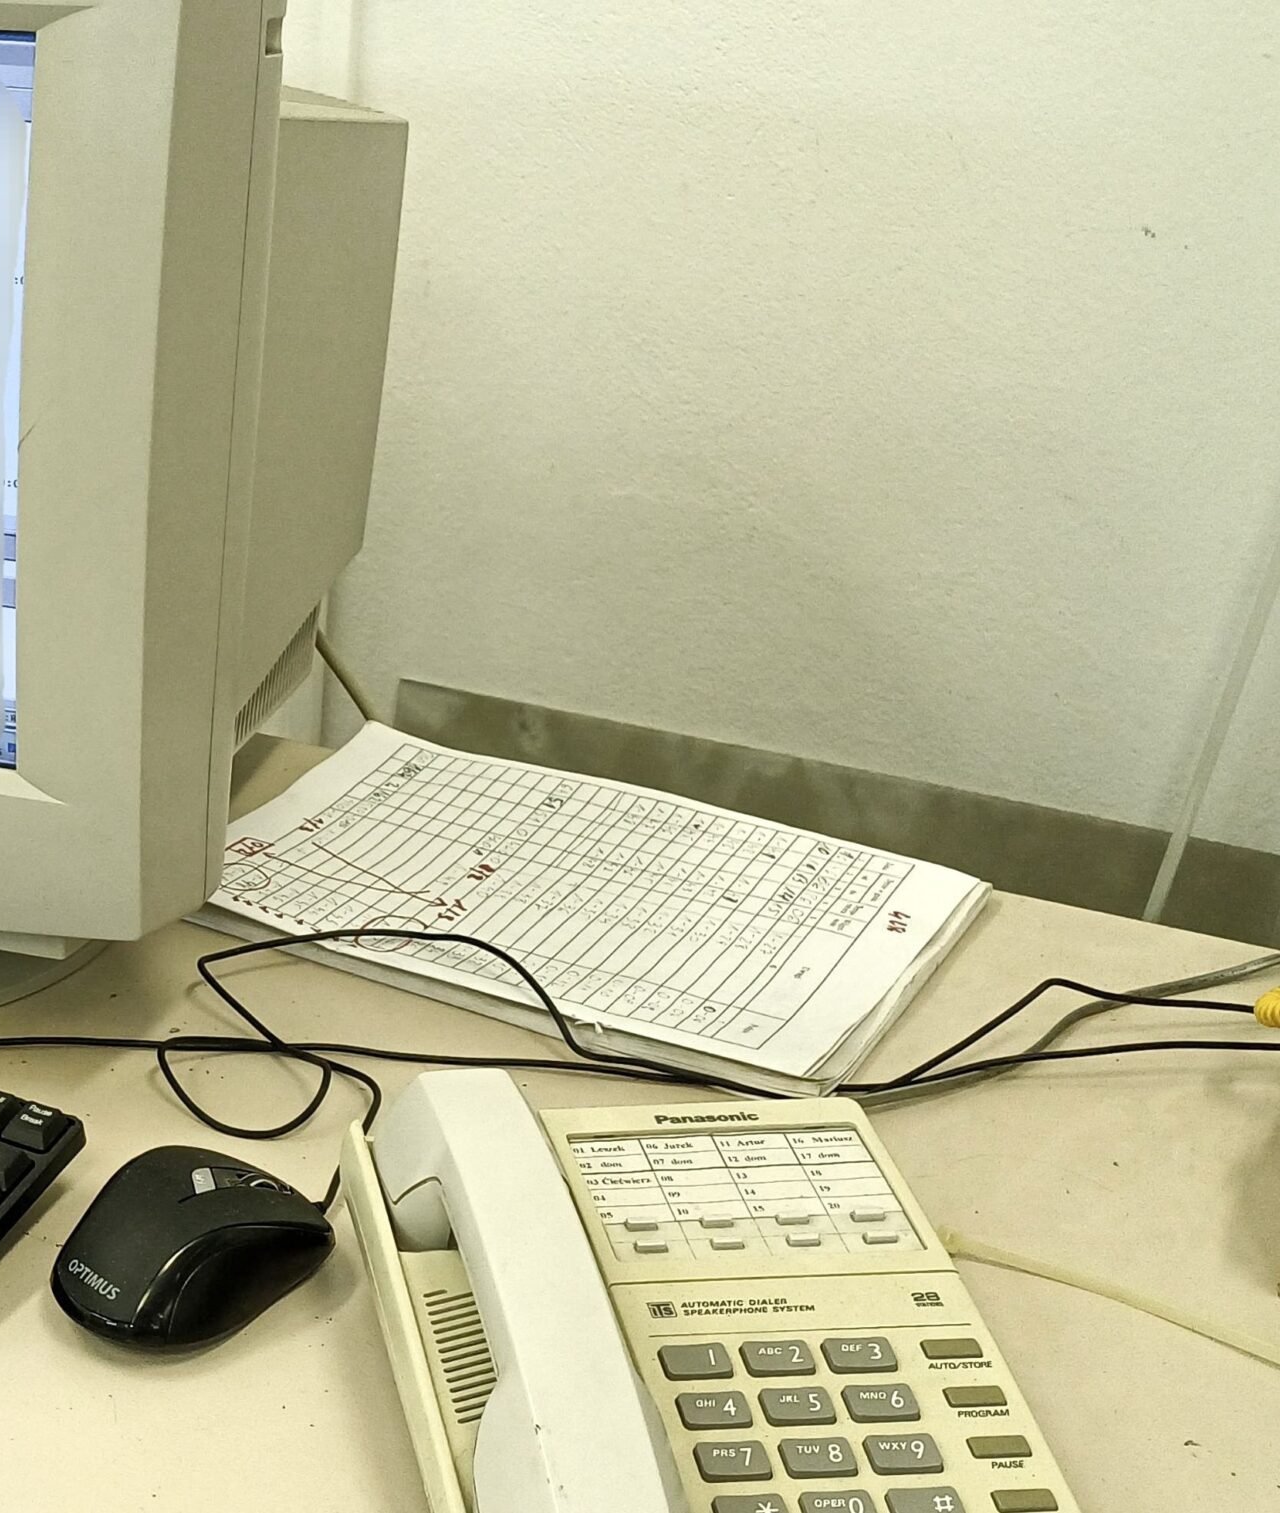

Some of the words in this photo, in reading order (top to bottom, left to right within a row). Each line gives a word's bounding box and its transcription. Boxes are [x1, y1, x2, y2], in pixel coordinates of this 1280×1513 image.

[29, 1105, 52, 1116] Pause
[21, 1114, 43, 1125] Break
[654, 1112, 759, 1124] Panasonic
[737, 1138, 766, 1147] Artur
[653, 1158, 665, 1166] 07
[69, 1260, 120, 1299] OPTIMUS
[911, 1292, 940, 1301] 28
[680, 1299, 744, 1308] AUTOMATIC
[749, 1298, 787, 1307] DIALER
[684, 1307, 767, 1316] SPEAKERPHONE
[709, 1349, 715, 1365] 1
[789, 1346, 803, 1362] 2
[868, 1344, 881, 1359] 3
[928, 1361, 992, 1369] AUTO/STORE
[809, 1394, 820, 1411] 5
[891, 1391, 904, 1408] 6
[696, 1399, 715, 1407] GHI
[724, 1399, 736, 1415] 4
[958, 1409, 1009, 1417] PROGRAM
[828, 1444, 842, 1462] 8
[879, 1442, 906, 1450] WXY
[911, 1441, 924, 1458] 9
[713, 1449, 735, 1457] PRS
[740, 1448, 751, 1466] 7
[992, 1460, 1023, 1468] PAUSE
[815, 1499, 845, 1507] OPER
